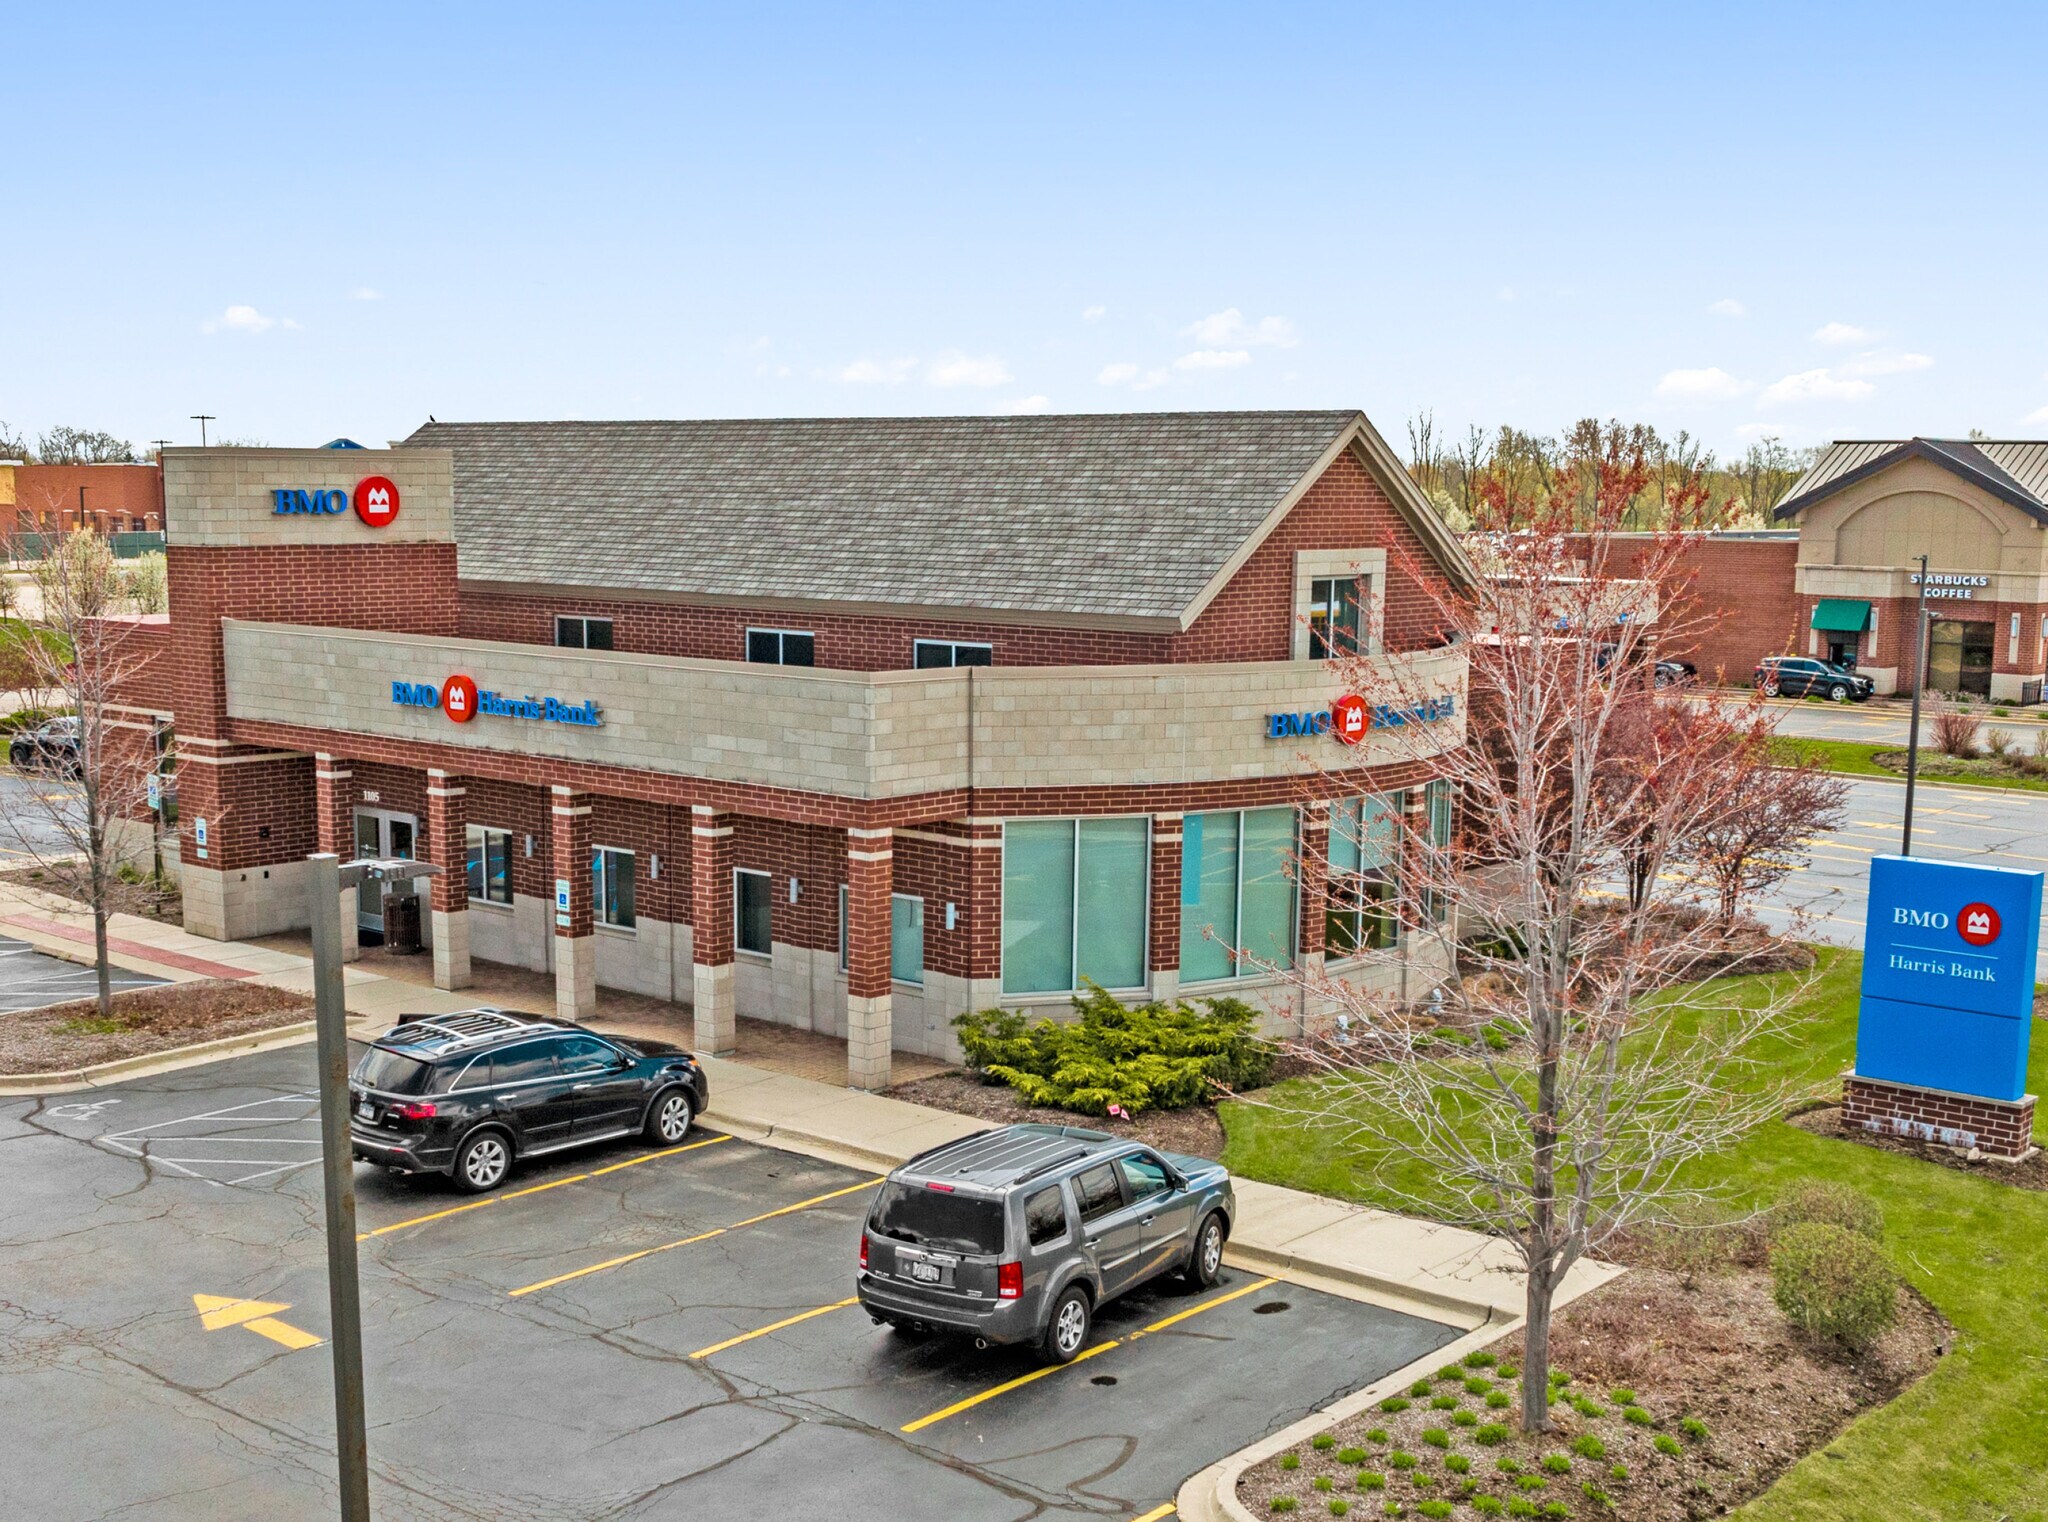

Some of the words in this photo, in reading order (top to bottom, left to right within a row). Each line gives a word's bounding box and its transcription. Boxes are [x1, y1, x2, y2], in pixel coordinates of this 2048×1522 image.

[272, 489, 348, 514] BMO
[1924, 588, 1972, 599] COFFEE
[391, 681, 438, 708] BMO
[477, 690, 542, 720] Harris
[544, 697, 602, 727] Bank
[1268, 711, 1331, 738] BMO
[363, 790, 380, 802] 1105
[1892, 907, 1949, 930] BMO
[1889, 954, 1946, 975] Harris
[1950, 962, 1997, 982] Bank
